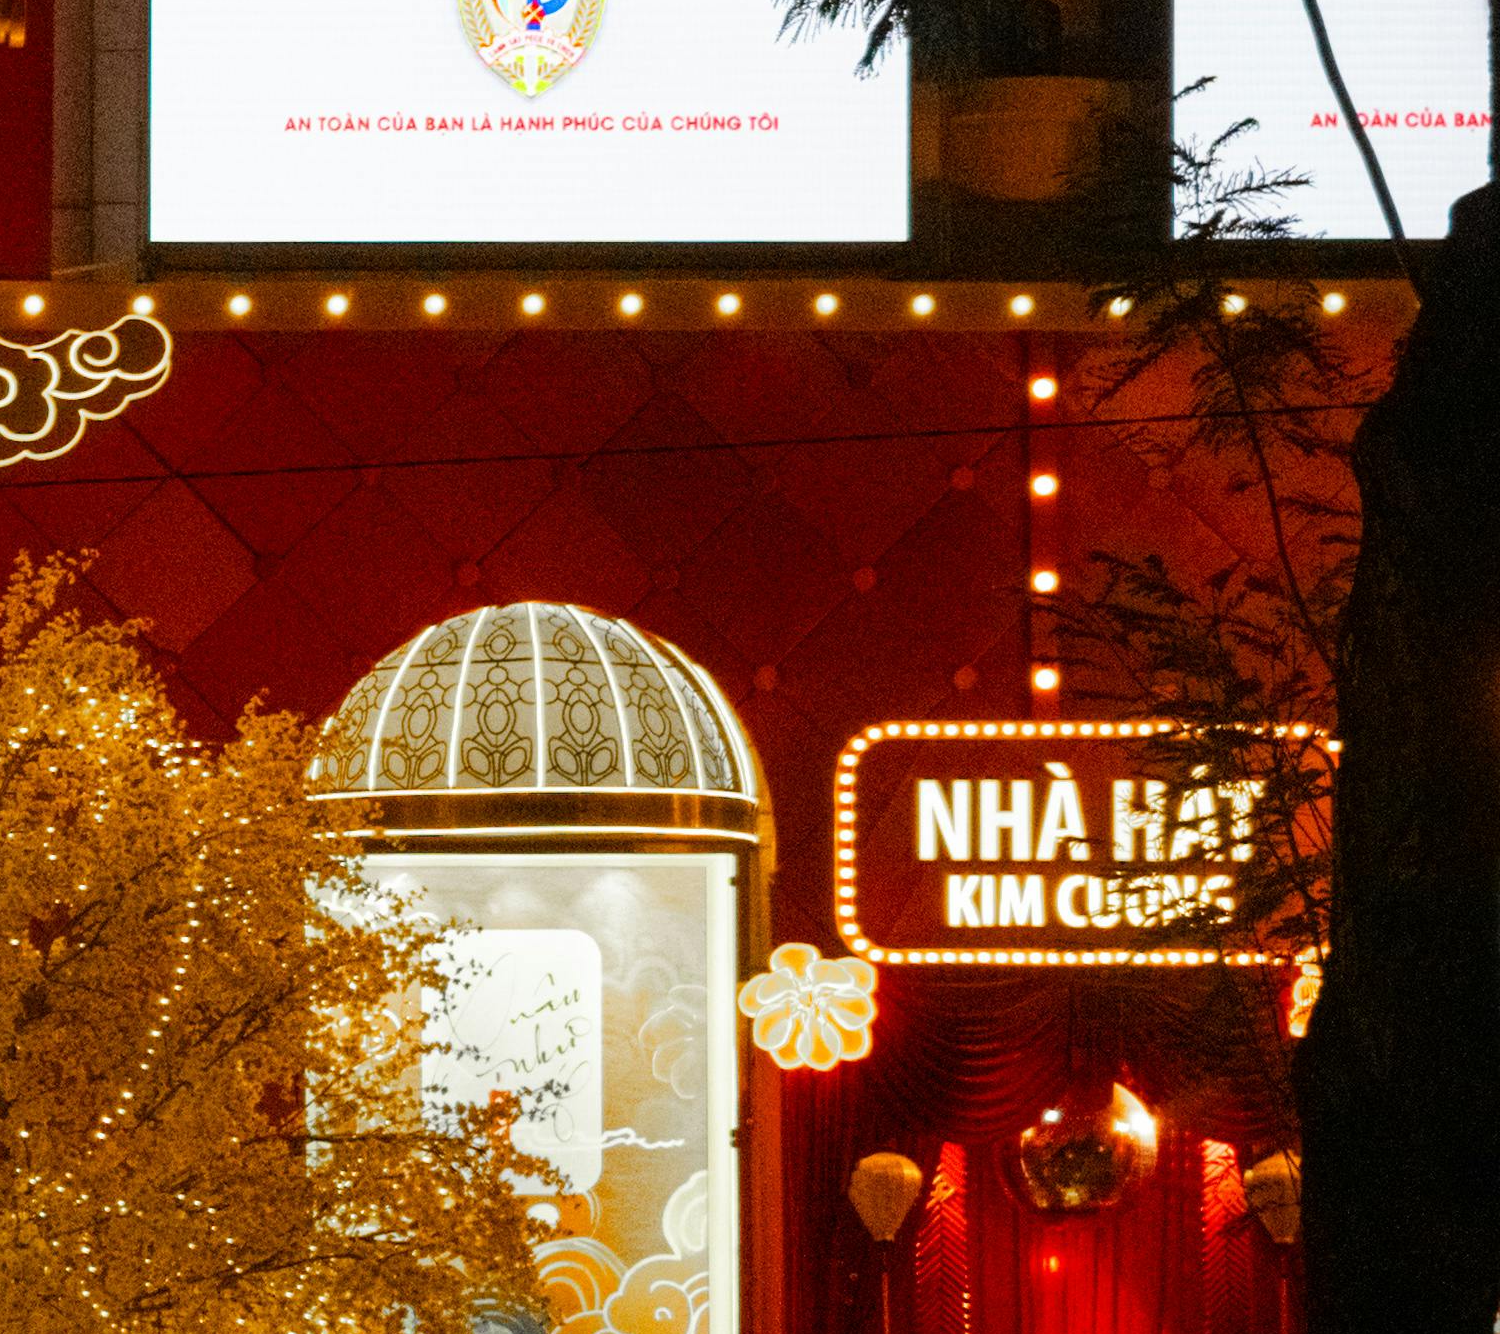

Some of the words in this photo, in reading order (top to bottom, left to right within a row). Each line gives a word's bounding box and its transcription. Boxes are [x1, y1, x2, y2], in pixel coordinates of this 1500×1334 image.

[285, 116, 311, 132] AN
[318, 112, 370, 132] TOÀN
[377, 112, 417, 132] CỦA
[471, 112, 493, 132] LÀ
[562, 112, 614, 132] PHÚC
[621, 112, 663, 132] CỦA
[670, 112, 742, 132] CHÚNG
[749, 112, 780, 132] TÔI
[1357, 108, 1399, 129] OÀN
[917, 761, 1091, 862] NHÀ
[947, 873, 1046, 927] KIM
